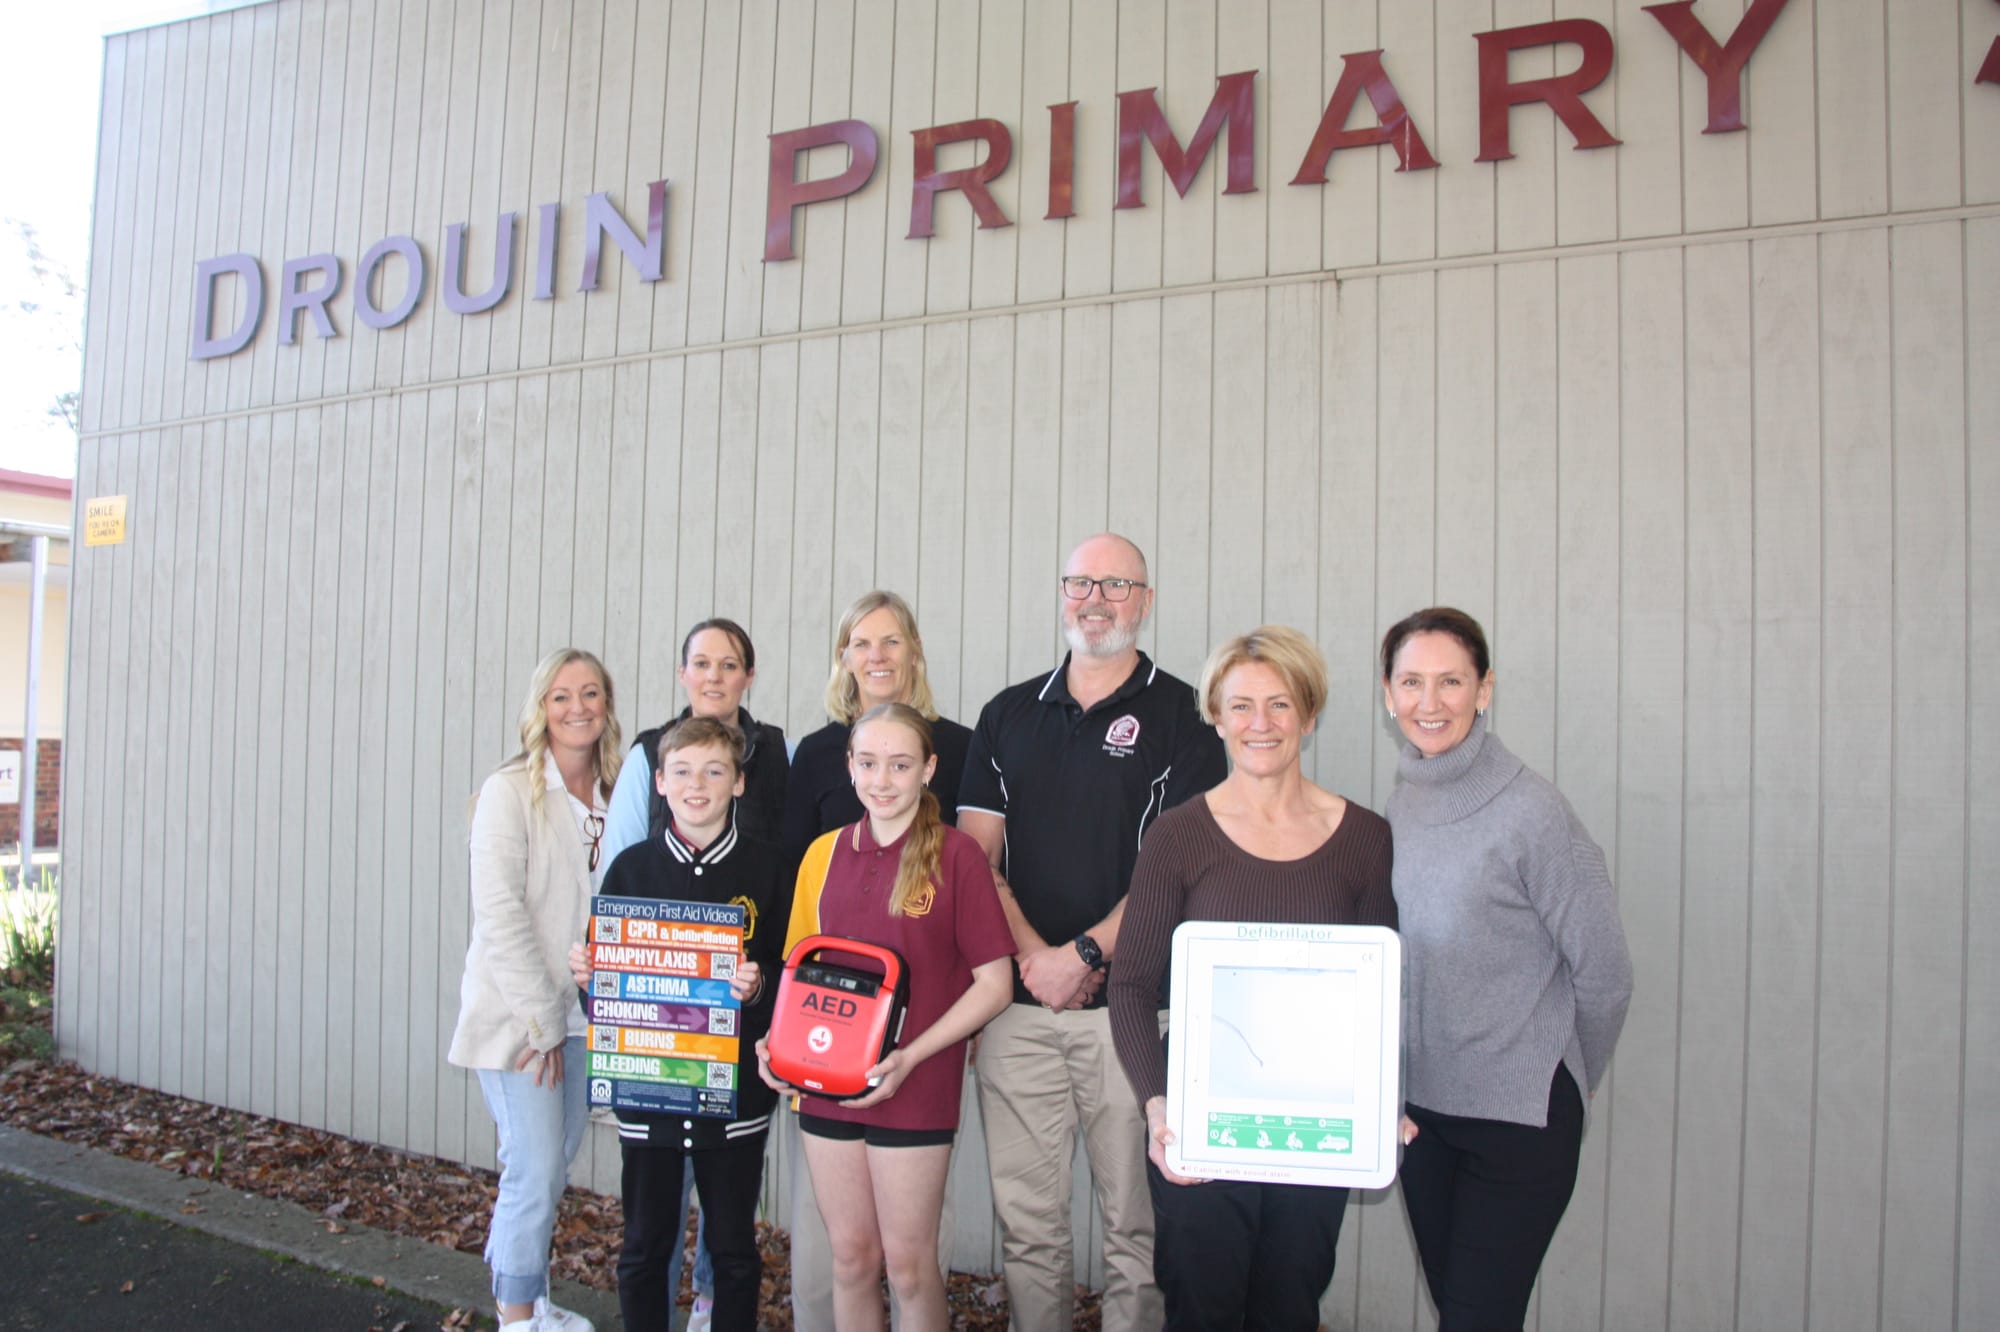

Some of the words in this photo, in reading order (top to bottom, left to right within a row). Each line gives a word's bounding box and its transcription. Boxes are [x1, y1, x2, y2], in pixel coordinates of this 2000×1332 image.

[192, 179, 669, 361] DROUIN
[761, 0, 1789, 263] PRIMARY
[89, 505, 113, 518] SMILE
[597, 899, 657, 919] Emergency
[659, 903, 681, 920] First
[682, 905, 700, 921] Aid
[702, 907, 738, 924] Videos
[627, 921, 658, 939] CPR
[660, 927, 669, 940] &
[671, 928, 738, 945] Defibrillation
[1237, 925, 1333, 940] Defibrillator
[595, 945, 698, 970] ANAPHYLAXIS
[626, 975, 690, 997] ASTHMA
[593, 999, 658, 1022] CHOKING
[801, 992, 857, 1018] AED
[624, 1029, 676, 1050] BURNS
[592, 1054, 661, 1076] BLEEDING
[591, 1086, 612, 1098] 000
